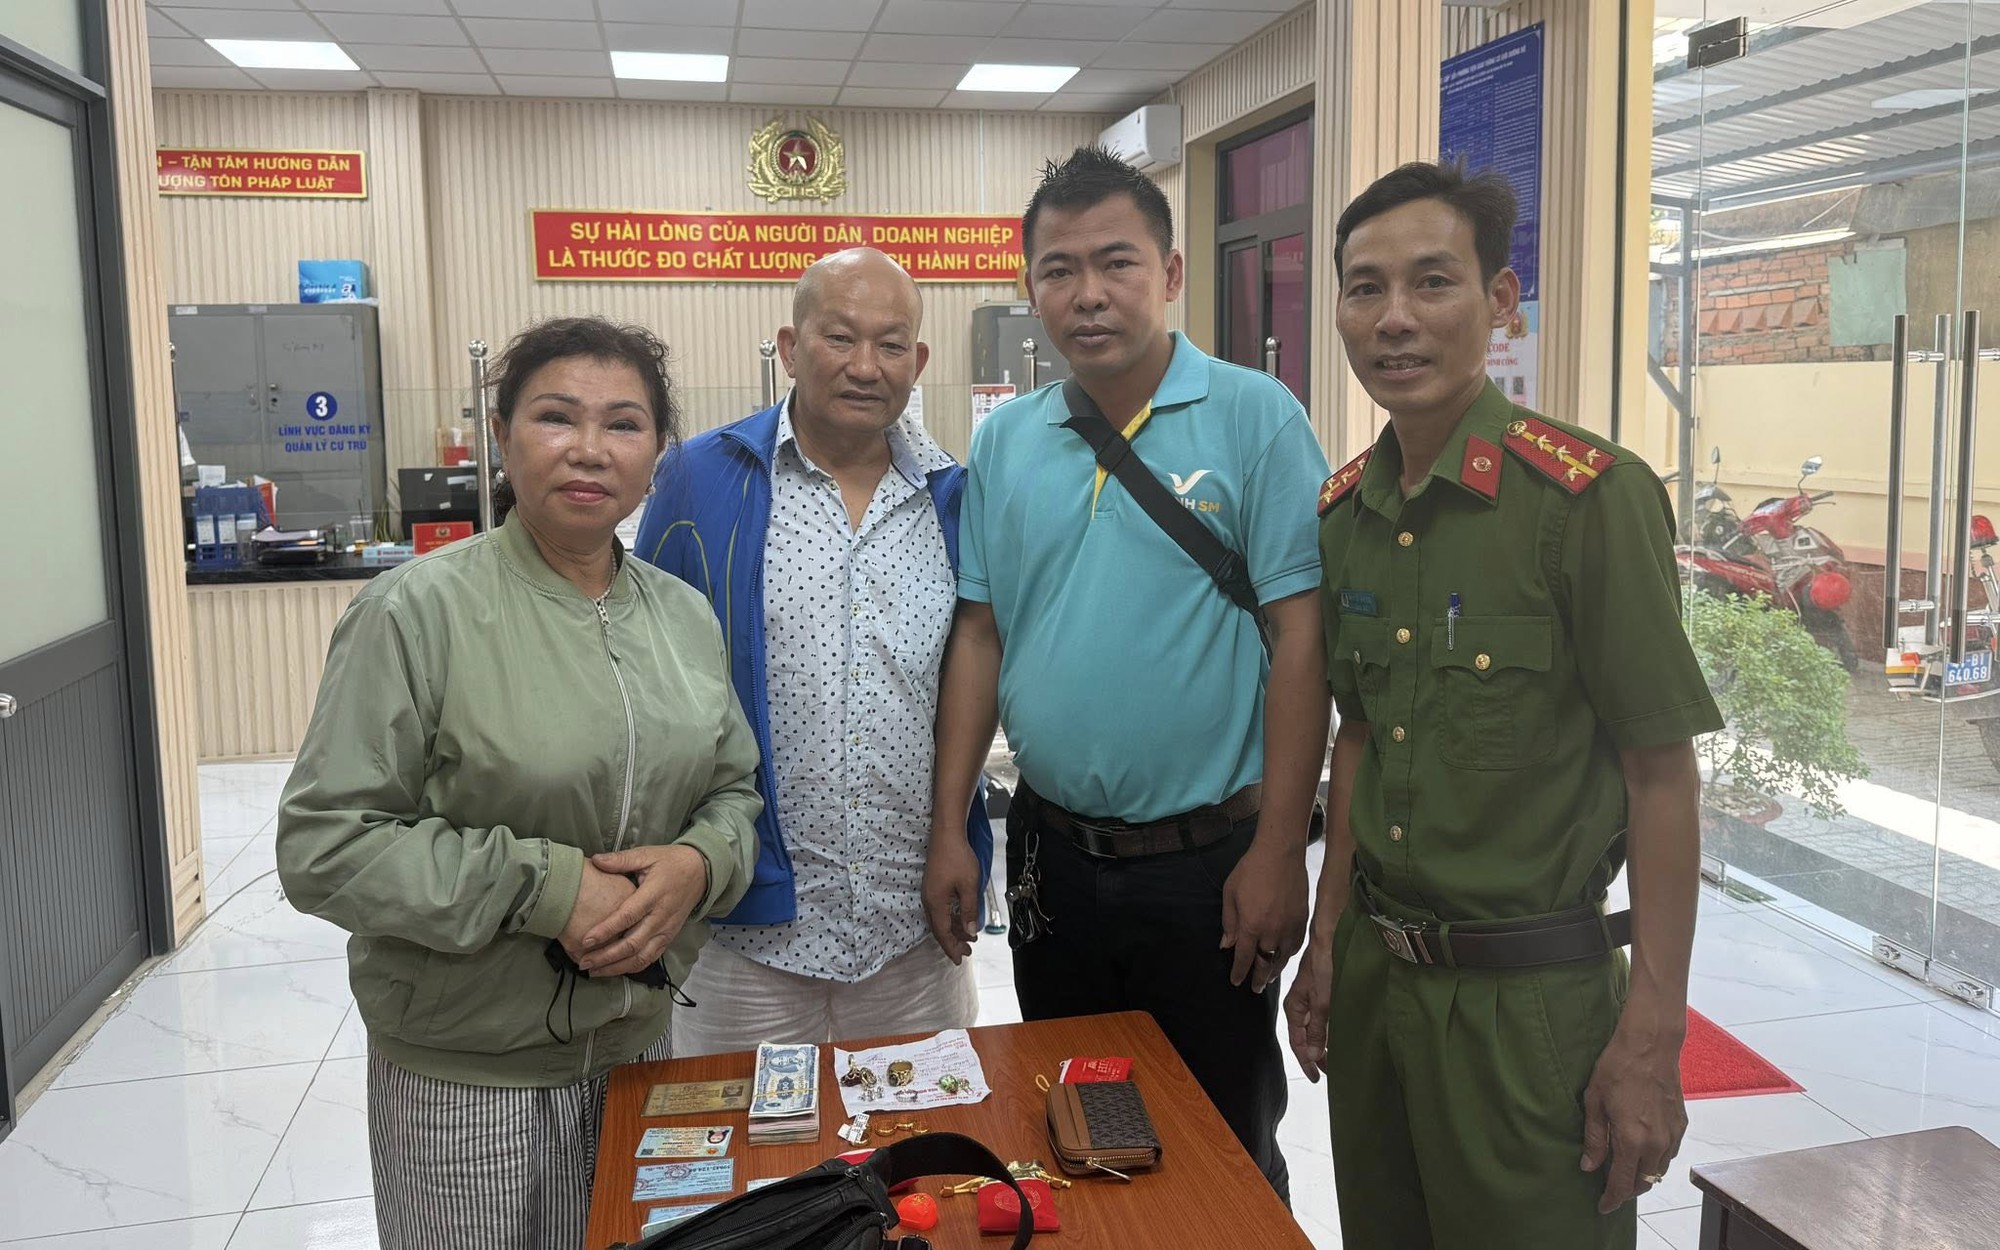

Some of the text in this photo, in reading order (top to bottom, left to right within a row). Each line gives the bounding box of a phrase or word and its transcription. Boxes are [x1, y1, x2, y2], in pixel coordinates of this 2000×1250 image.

[181, 154, 212, 172] TẬN
[216, 155, 249, 170] TÂM
[253, 155, 313, 171] HƯỚNG
[317, 155, 351, 171] DẪN
[210, 174, 243, 189] TÔN
[248, 174, 292, 189] PHÁP
[296, 175, 336, 192] LUẬT
[570, 219, 1014, 248] SỰ HÀI LÒNG CỦA NGƯỜI DÂN, DOANH NGHIỆP
[549, 246, 576, 268] LÀ
[579, 246, 651, 268] THƯỚC
[656, 250, 687, 269] ĐO
[692, 246, 744, 269] CHẤT
[750, 249, 816, 273] LƯỢNG
[918, 250, 969, 270] HÀNH
[315, 395, 328, 417] 3
[1198, 500, 1220, 513] SM
[1948, 665, 1987, 683] 640.68
